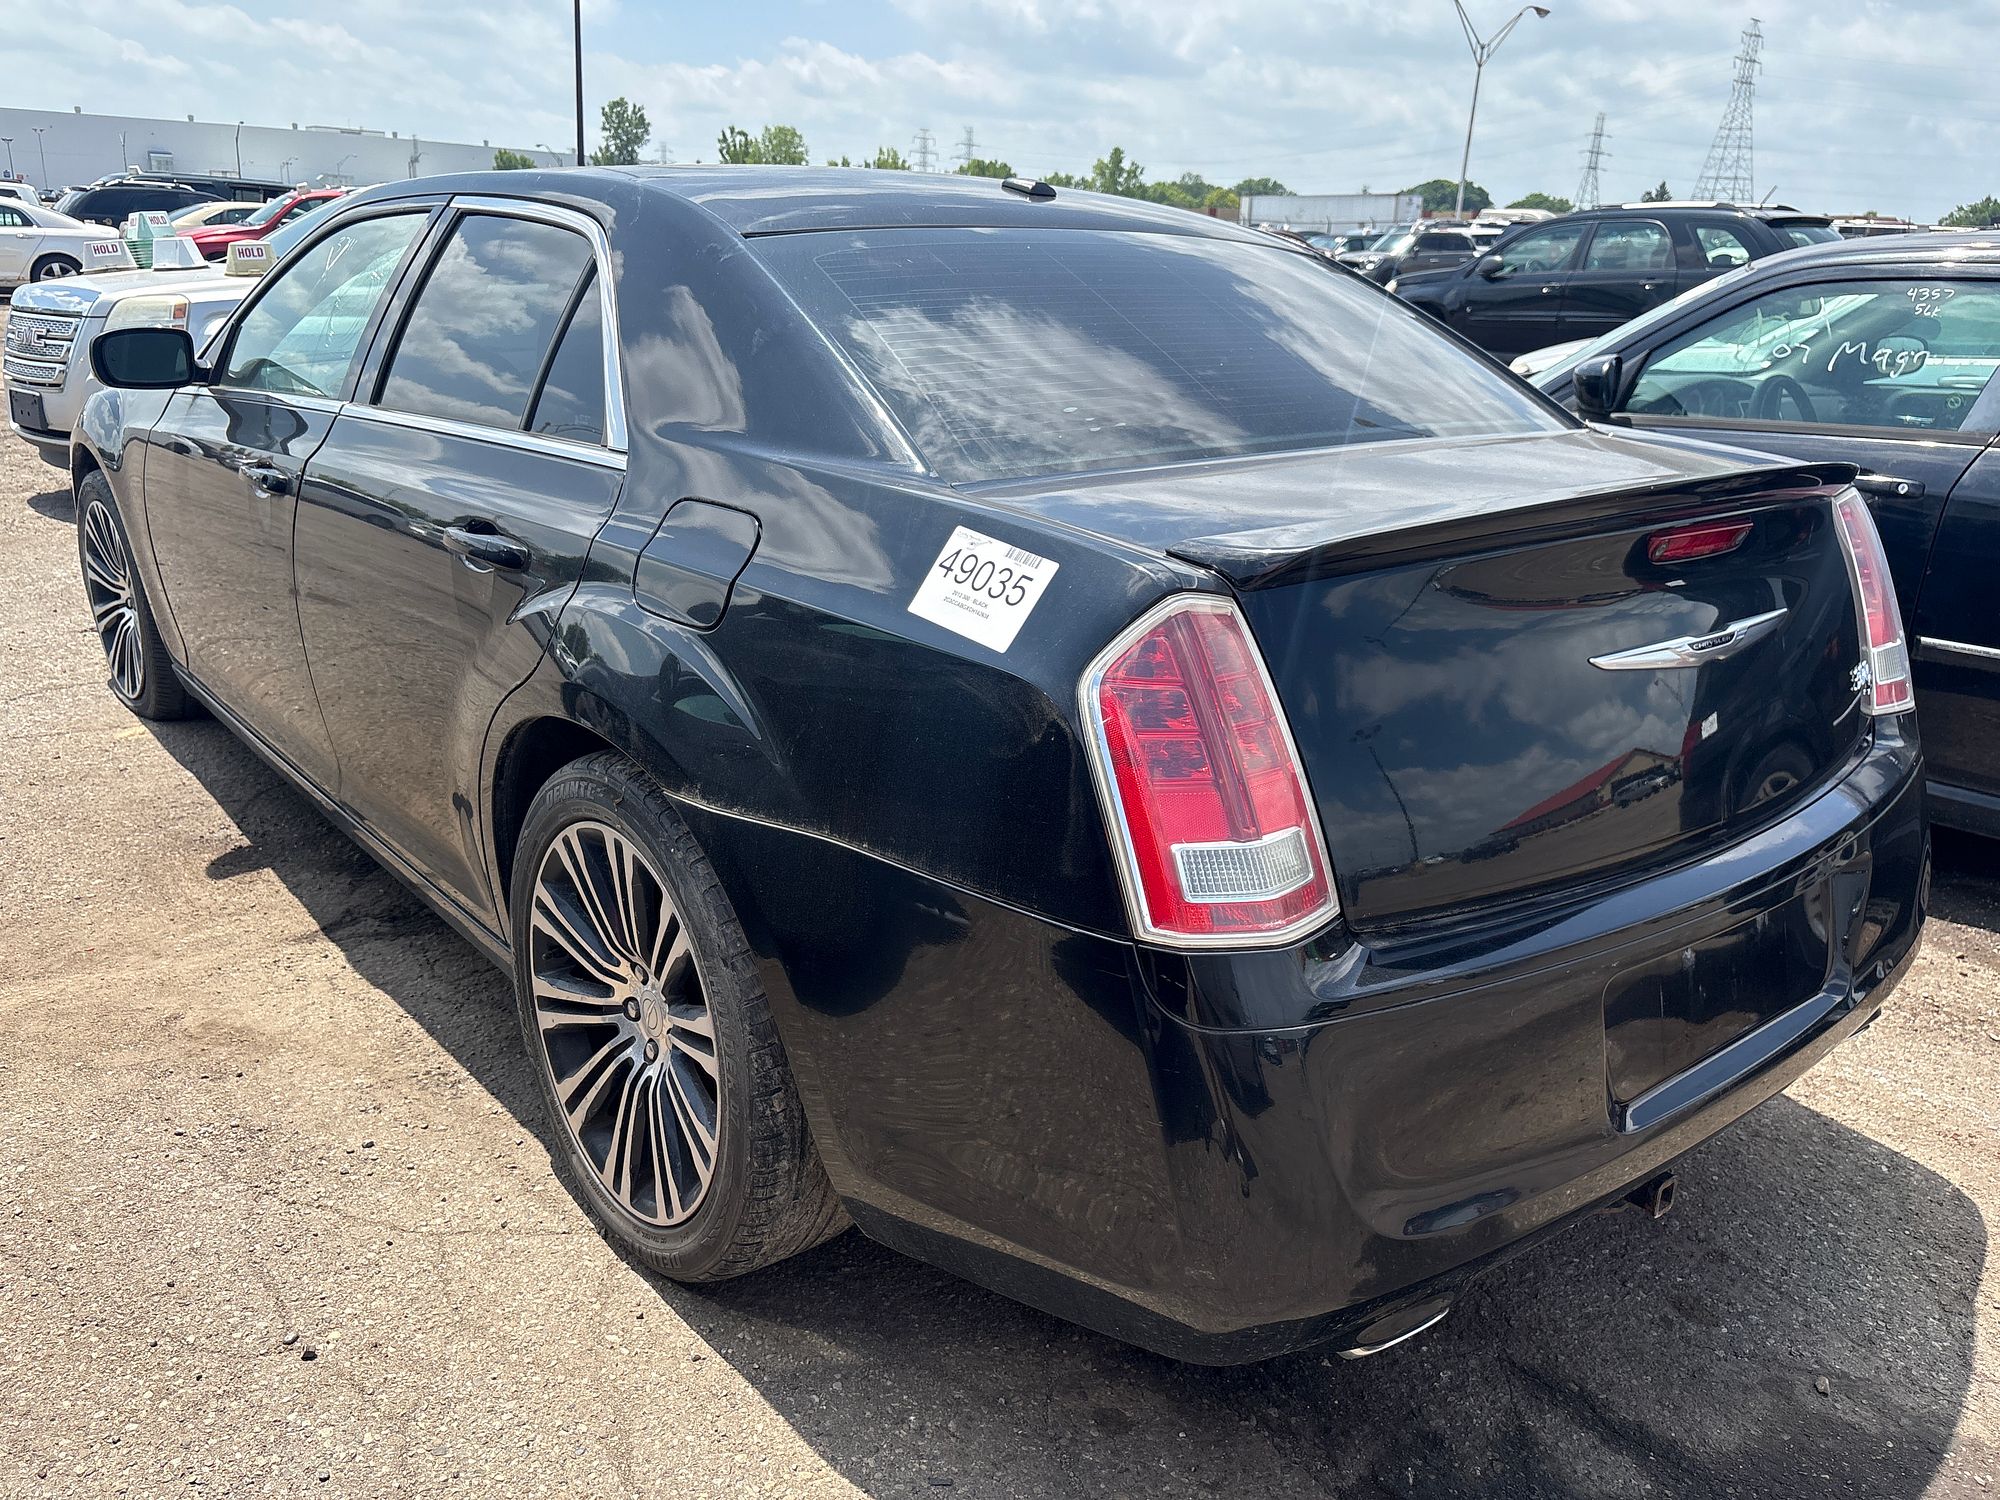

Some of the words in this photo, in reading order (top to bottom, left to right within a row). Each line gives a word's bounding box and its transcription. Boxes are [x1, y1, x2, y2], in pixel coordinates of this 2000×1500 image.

[147, 215, 168, 226] HOLD
[93, 243, 119, 256] HOLD
[237, 247, 264, 259] HOLD
[1907, 287, 1955, 302] 4357
[15, 327, 48, 348] GMC
[938, 548, 1034, 607] 49035
[973, 598, 988, 610] BLACK
